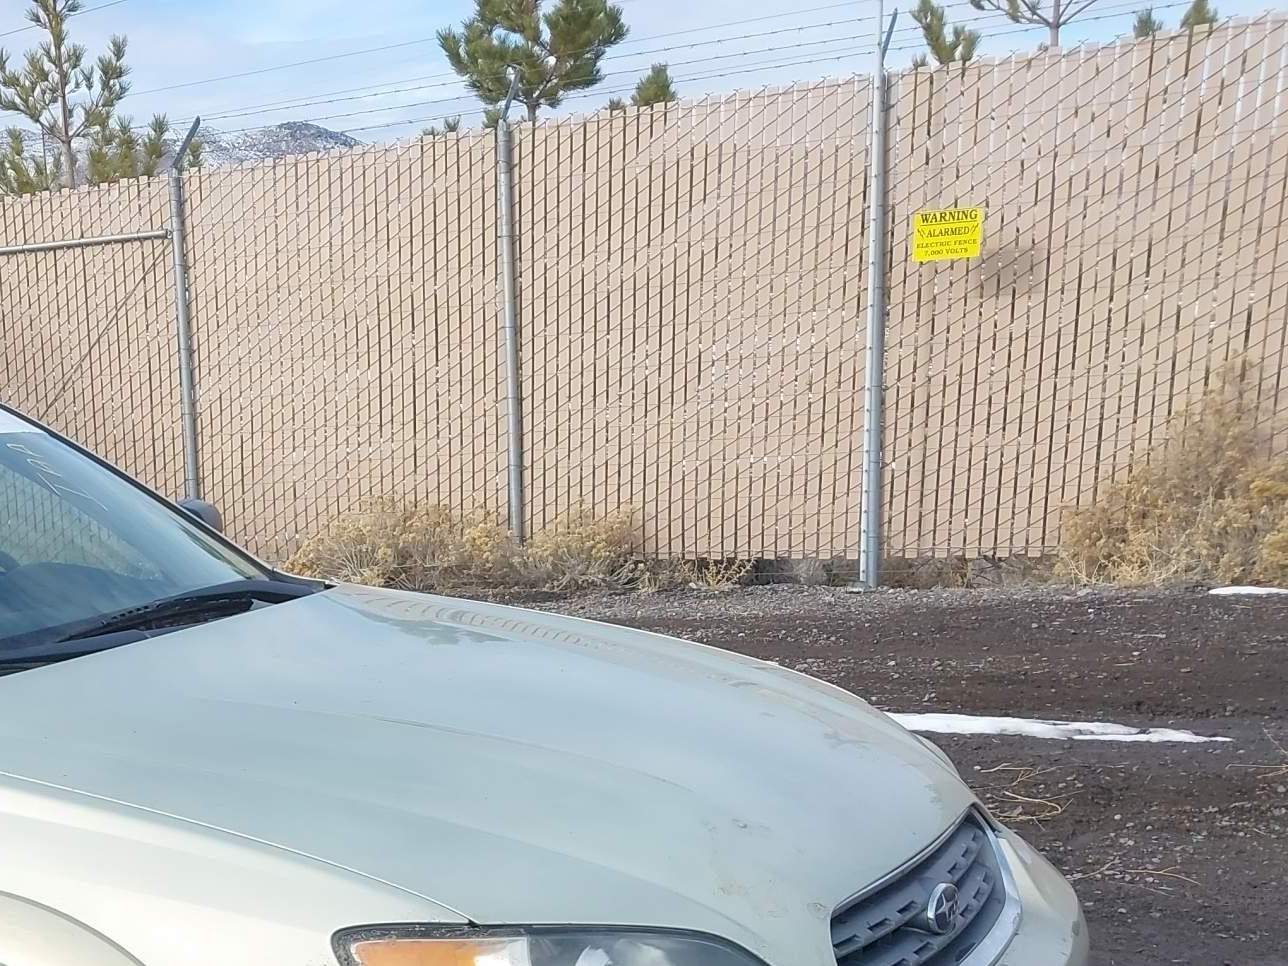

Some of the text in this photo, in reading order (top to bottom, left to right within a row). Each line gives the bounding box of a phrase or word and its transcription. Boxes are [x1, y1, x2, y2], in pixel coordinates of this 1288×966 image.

[920, 209, 978, 224] WARNING
[926, 226, 970, 238] ALARMED
[916, 238, 978, 249] ELECTRIC FENCE
[945, 247, 968, 255] VOLTS
